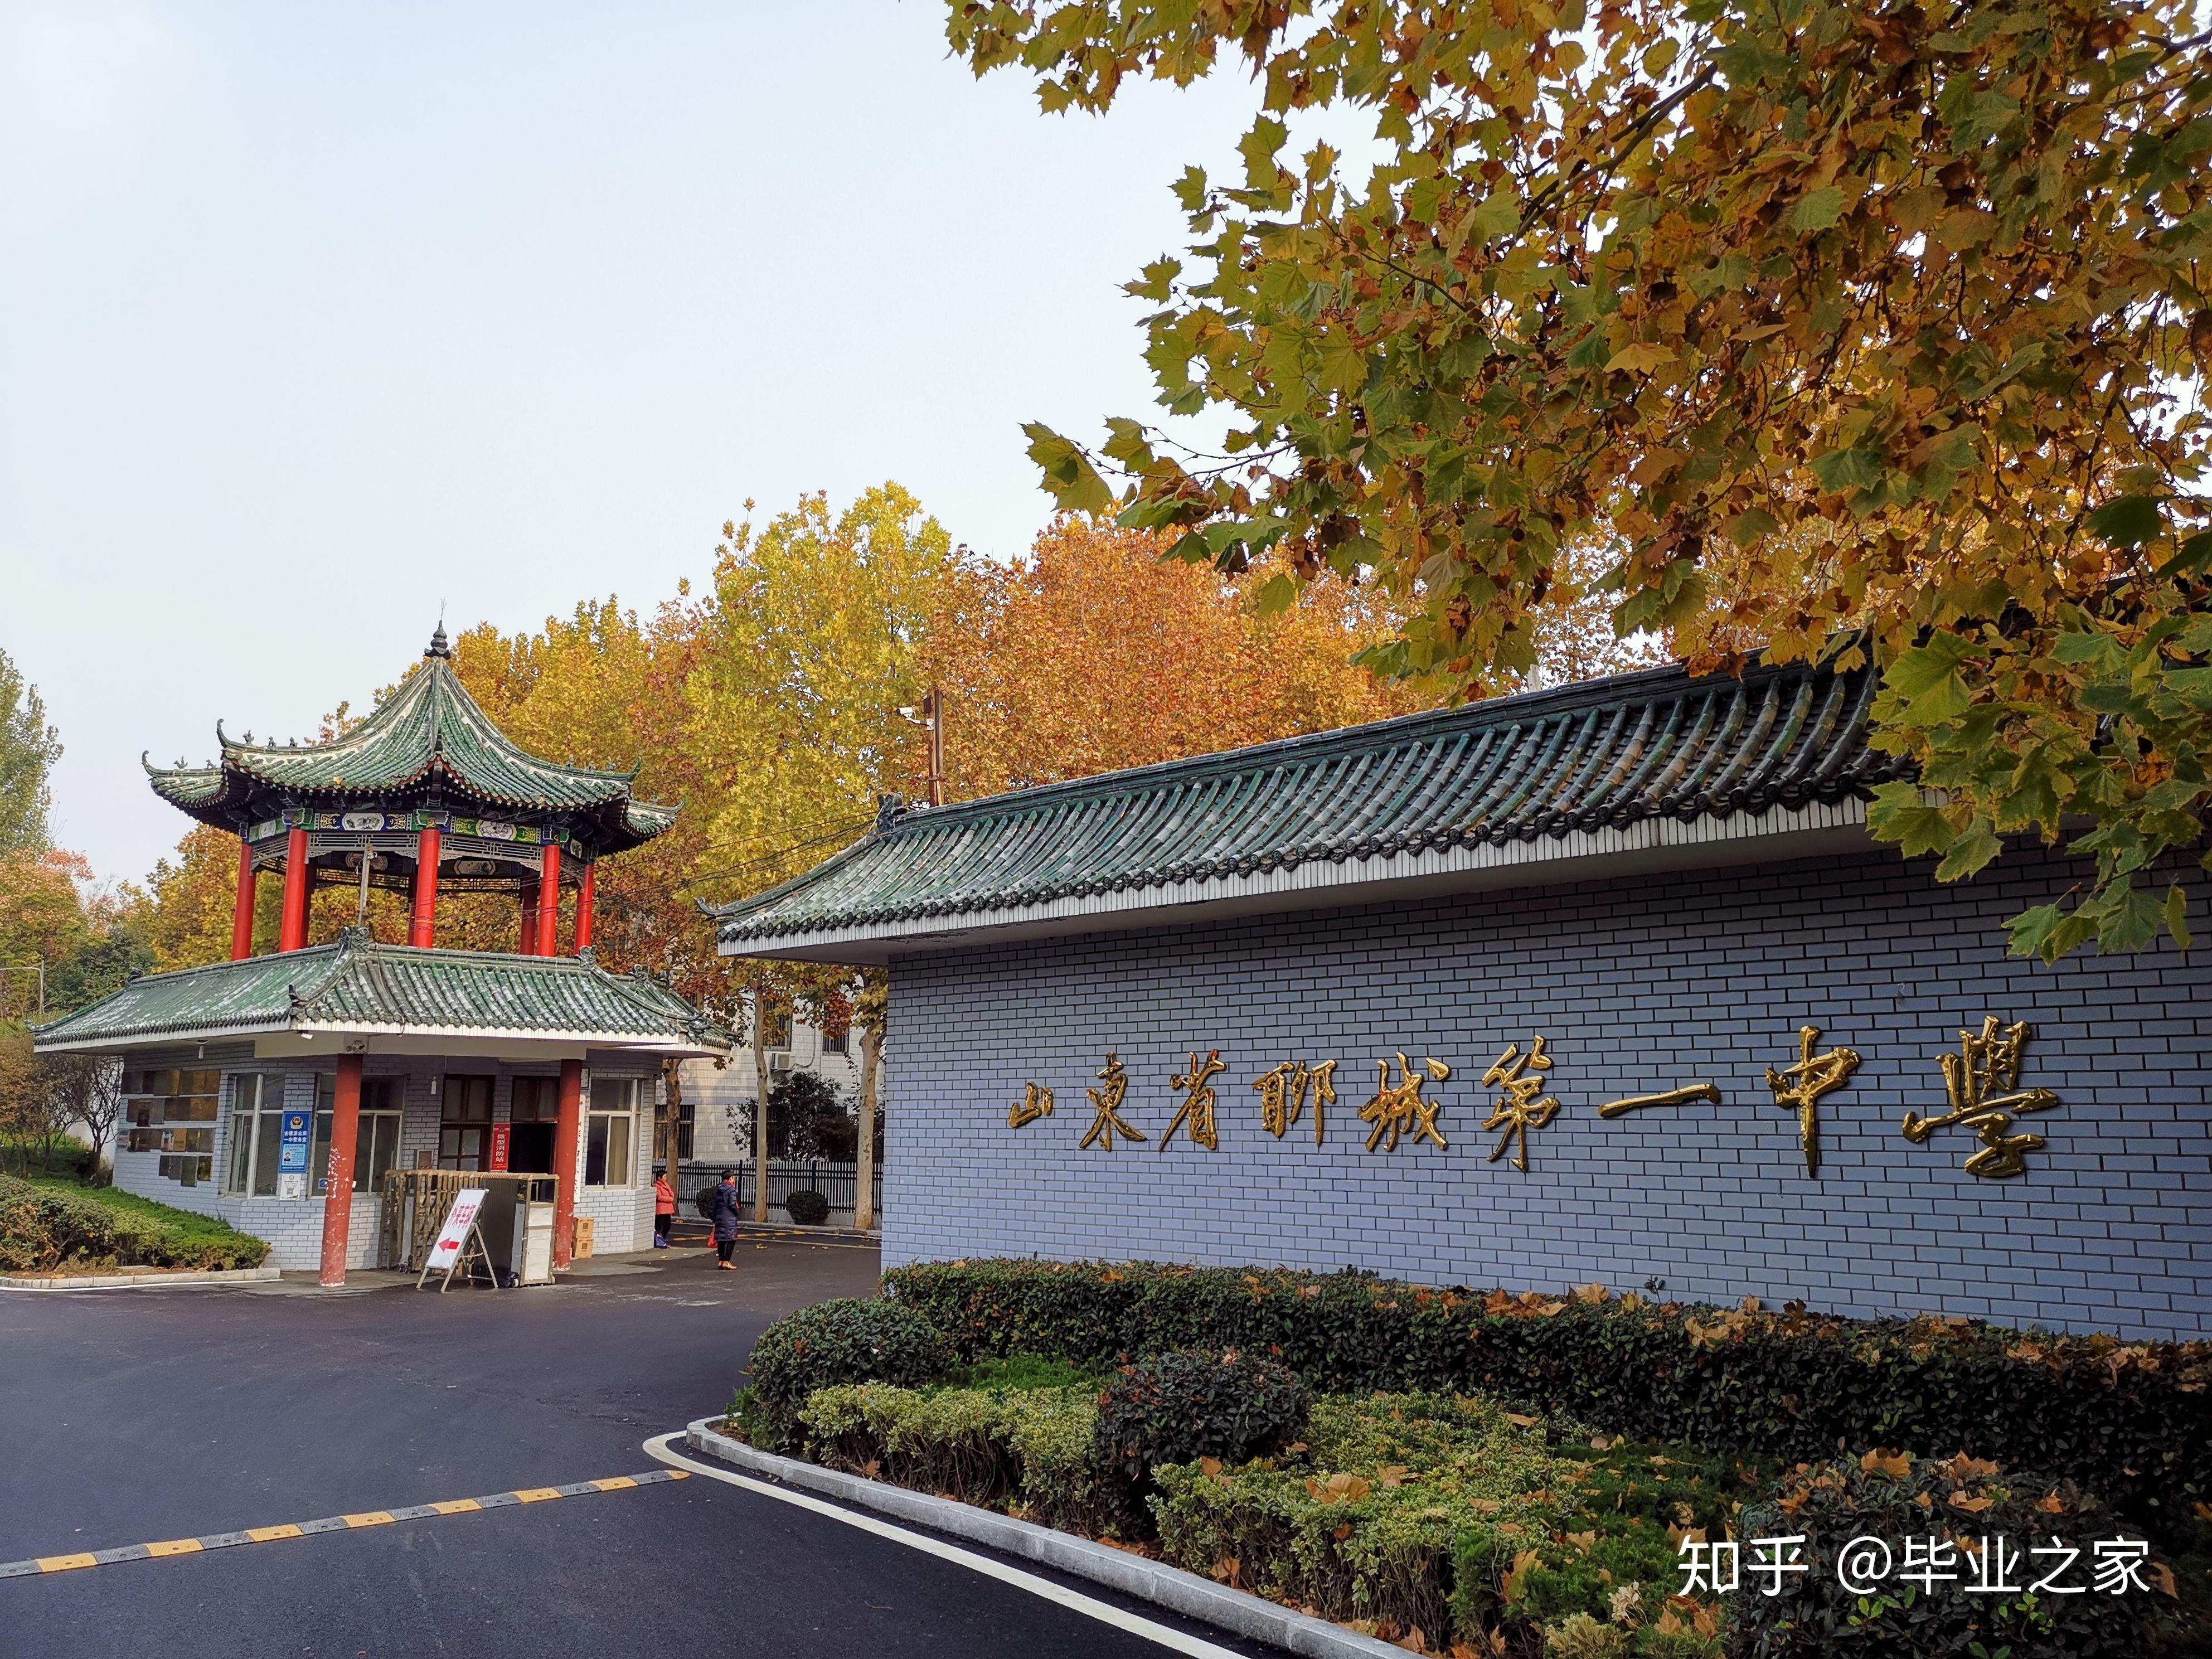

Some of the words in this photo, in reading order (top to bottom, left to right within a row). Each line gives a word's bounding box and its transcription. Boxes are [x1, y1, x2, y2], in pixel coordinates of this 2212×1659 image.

[495, 1134, 506, 1162] 微型消防站
